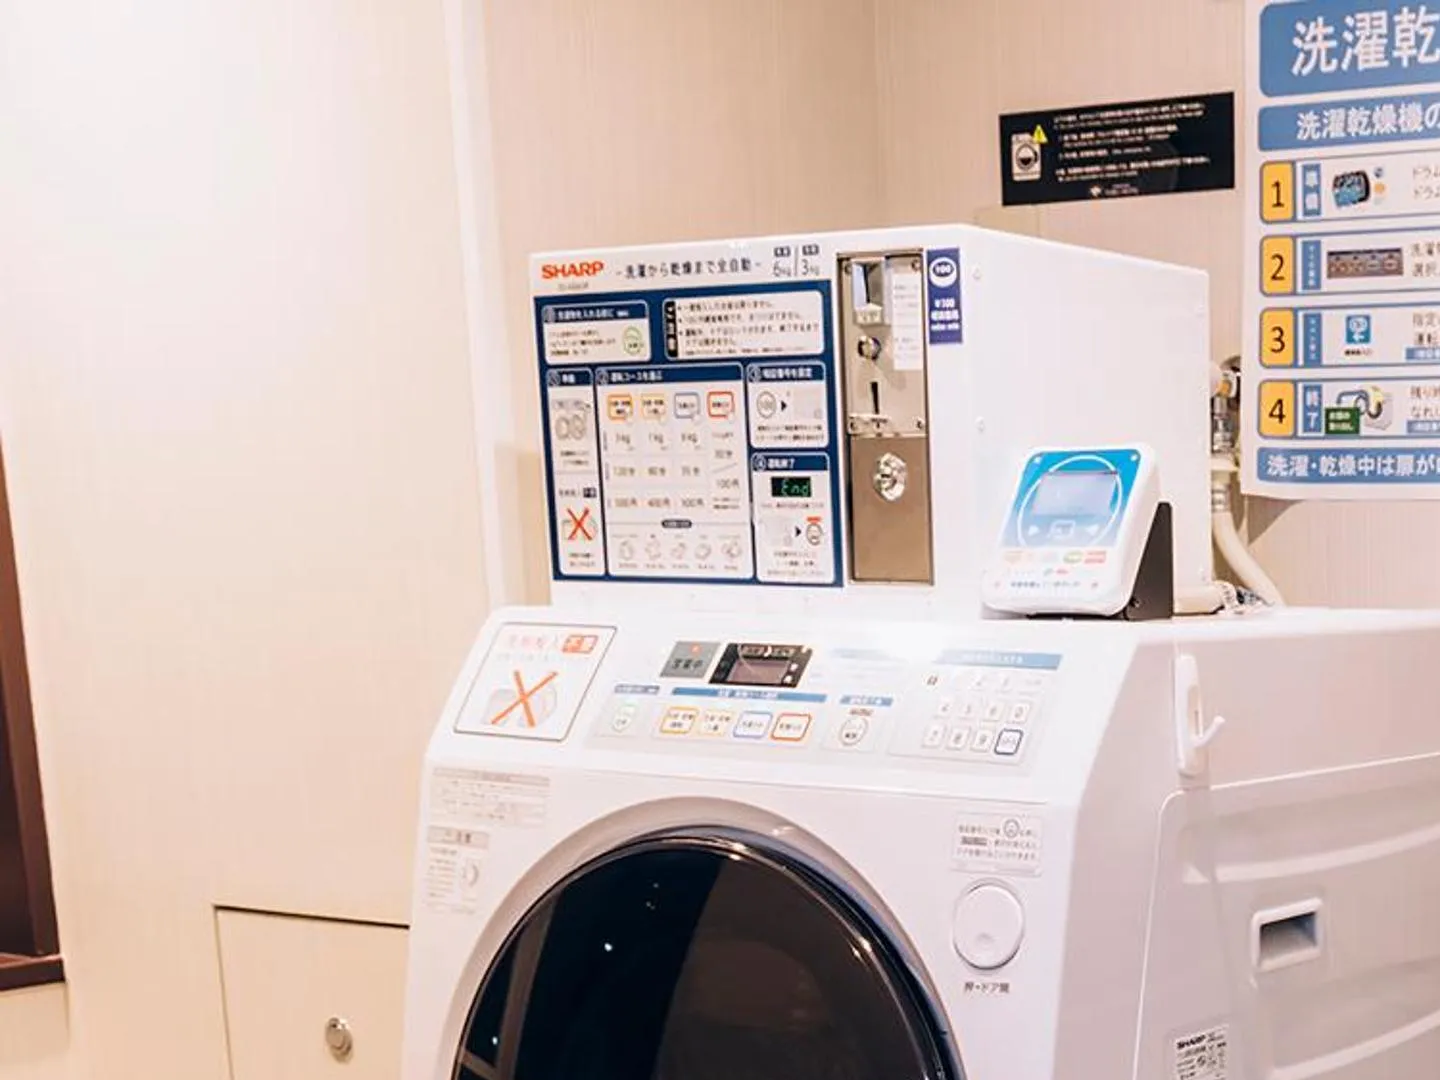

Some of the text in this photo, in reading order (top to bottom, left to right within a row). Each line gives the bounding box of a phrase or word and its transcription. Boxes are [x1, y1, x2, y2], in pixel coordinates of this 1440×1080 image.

[1271, 180, 1285, 208] 1
[541, 260, 605, 280] SHARP
[1271, 254, 1286, 281] 2
[1271, 326, 1286, 354] 3
[1269, 398, 1286, 424] 4
[780, 478, 811, 497] End
